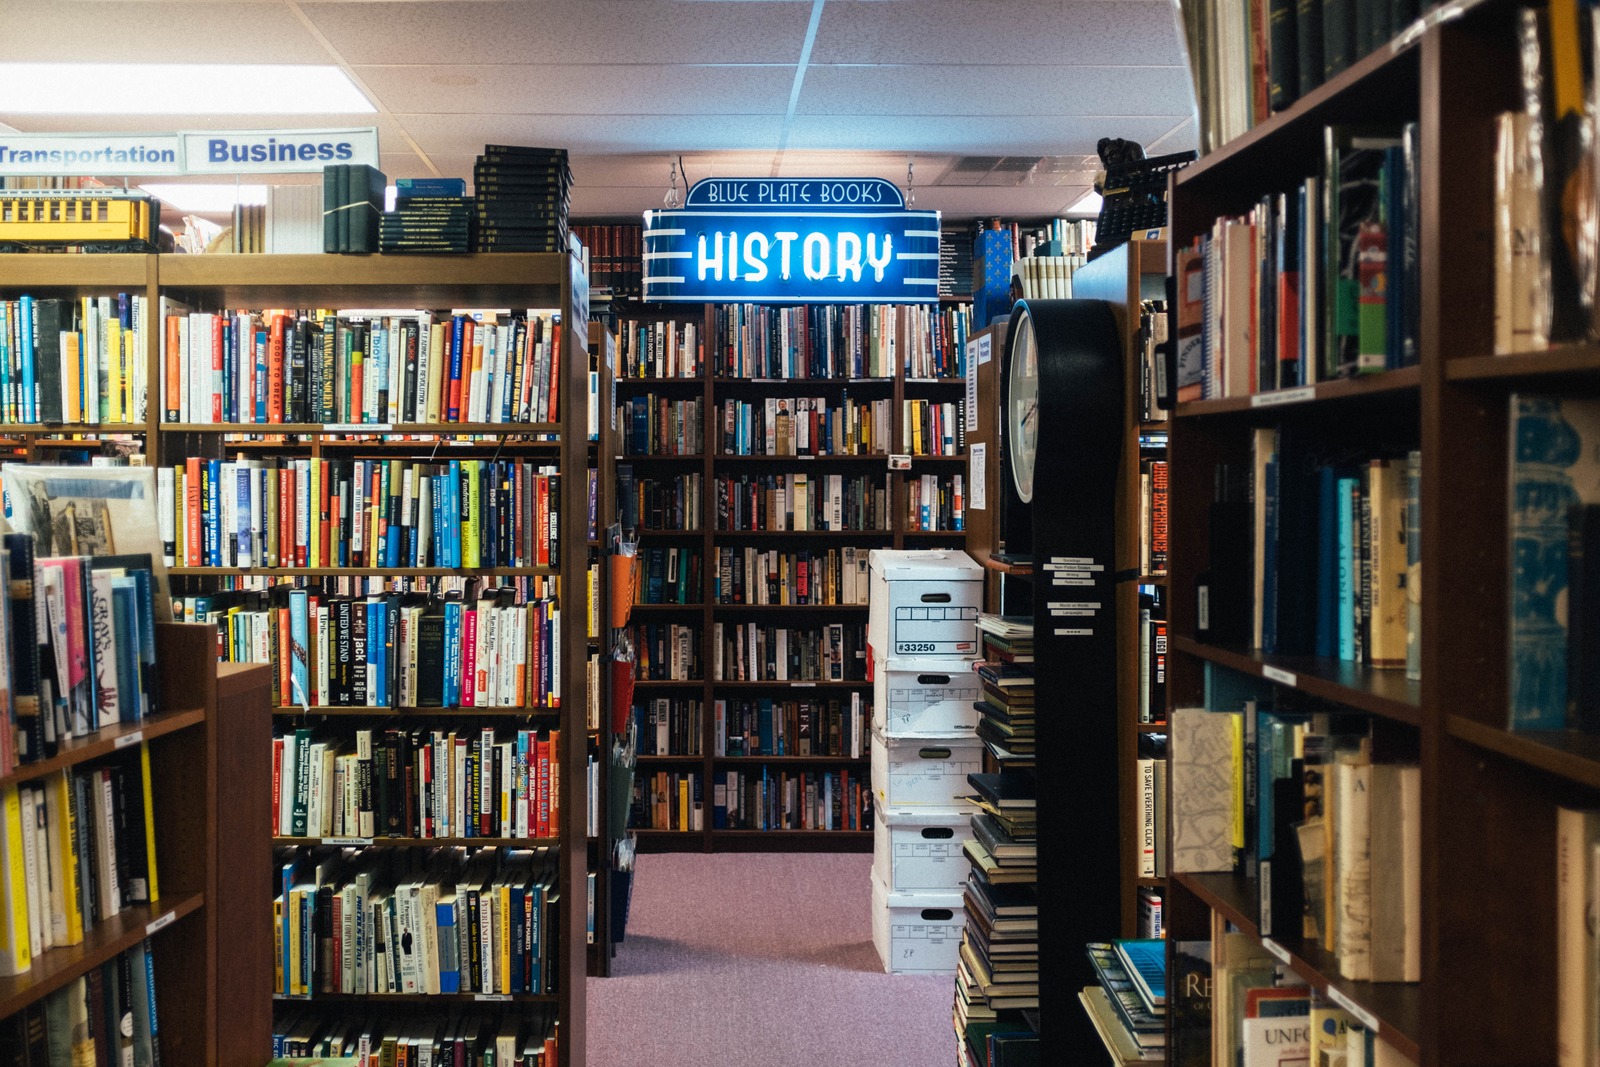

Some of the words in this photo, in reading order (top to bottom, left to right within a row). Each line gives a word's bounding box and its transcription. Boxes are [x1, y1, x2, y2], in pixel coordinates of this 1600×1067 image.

[0, 146, 174, 167] Transportation
[208, 137, 353, 163] Business
[708, 183, 749, 203] BLUE
[758, 183, 811, 203] PLATE
[820, 183, 883, 203] BOOKS
[697, 231, 894, 283] HISTORY
[323, 334, 334, 367] MANAGING
[407, 328, 415, 360] REWORK
[274, 368, 280, 377] TO
[324, 381, 334, 408] SOCIETY
[1152, 463, 1168, 489] DRUG
[189, 486, 198, 507] BAD
[1152, 492, 1168, 552] EXPERIENCE
[1361, 496, 1371, 548] BEYOND
[1372, 516, 1380, 542] WITH
[722, 557, 730, 566] THE
[1372, 545, 1380, 572] BYRD
[721, 567, 732, 596] RECKONING
[1339, 543, 1347, 605] ALONE
[1373, 574, 1379, 585] AT
[1361, 559, 1371, 617] BARRIER
[1372, 588, 1380, 608] THE
[91, 585, 104, 667] ANATOMY
[98, 597, 111, 652] GRAY'S
[340, 603, 349, 628] UNITED
[340, 629, 349, 639] WE
[1156, 626, 1167, 635] NO
[52, 627, 63, 670] COMPANIONS
[340, 641, 349, 662] STAND
[353, 638, 366, 661] jack
[899, 644, 935, 652] #33250
[1156, 637, 1166, 653] LOGO
[658, 701, 667, 722] CHAIRMAN
[1144, 765, 1152, 773] TO
[1144, 774, 1152, 791] SAVE
[104, 785, 113, 809] How
[106, 814, 115, 857] Doctors
[110, 863, 118, 895] Think
[481, 900, 489, 921] PETER
[344, 925, 352, 947] COMPANY
[344, 958, 352, 970] KEEP
[147, 957, 158, 1032] OVERDIAGNOSED
[383, 1044, 393, 1063] TONY
